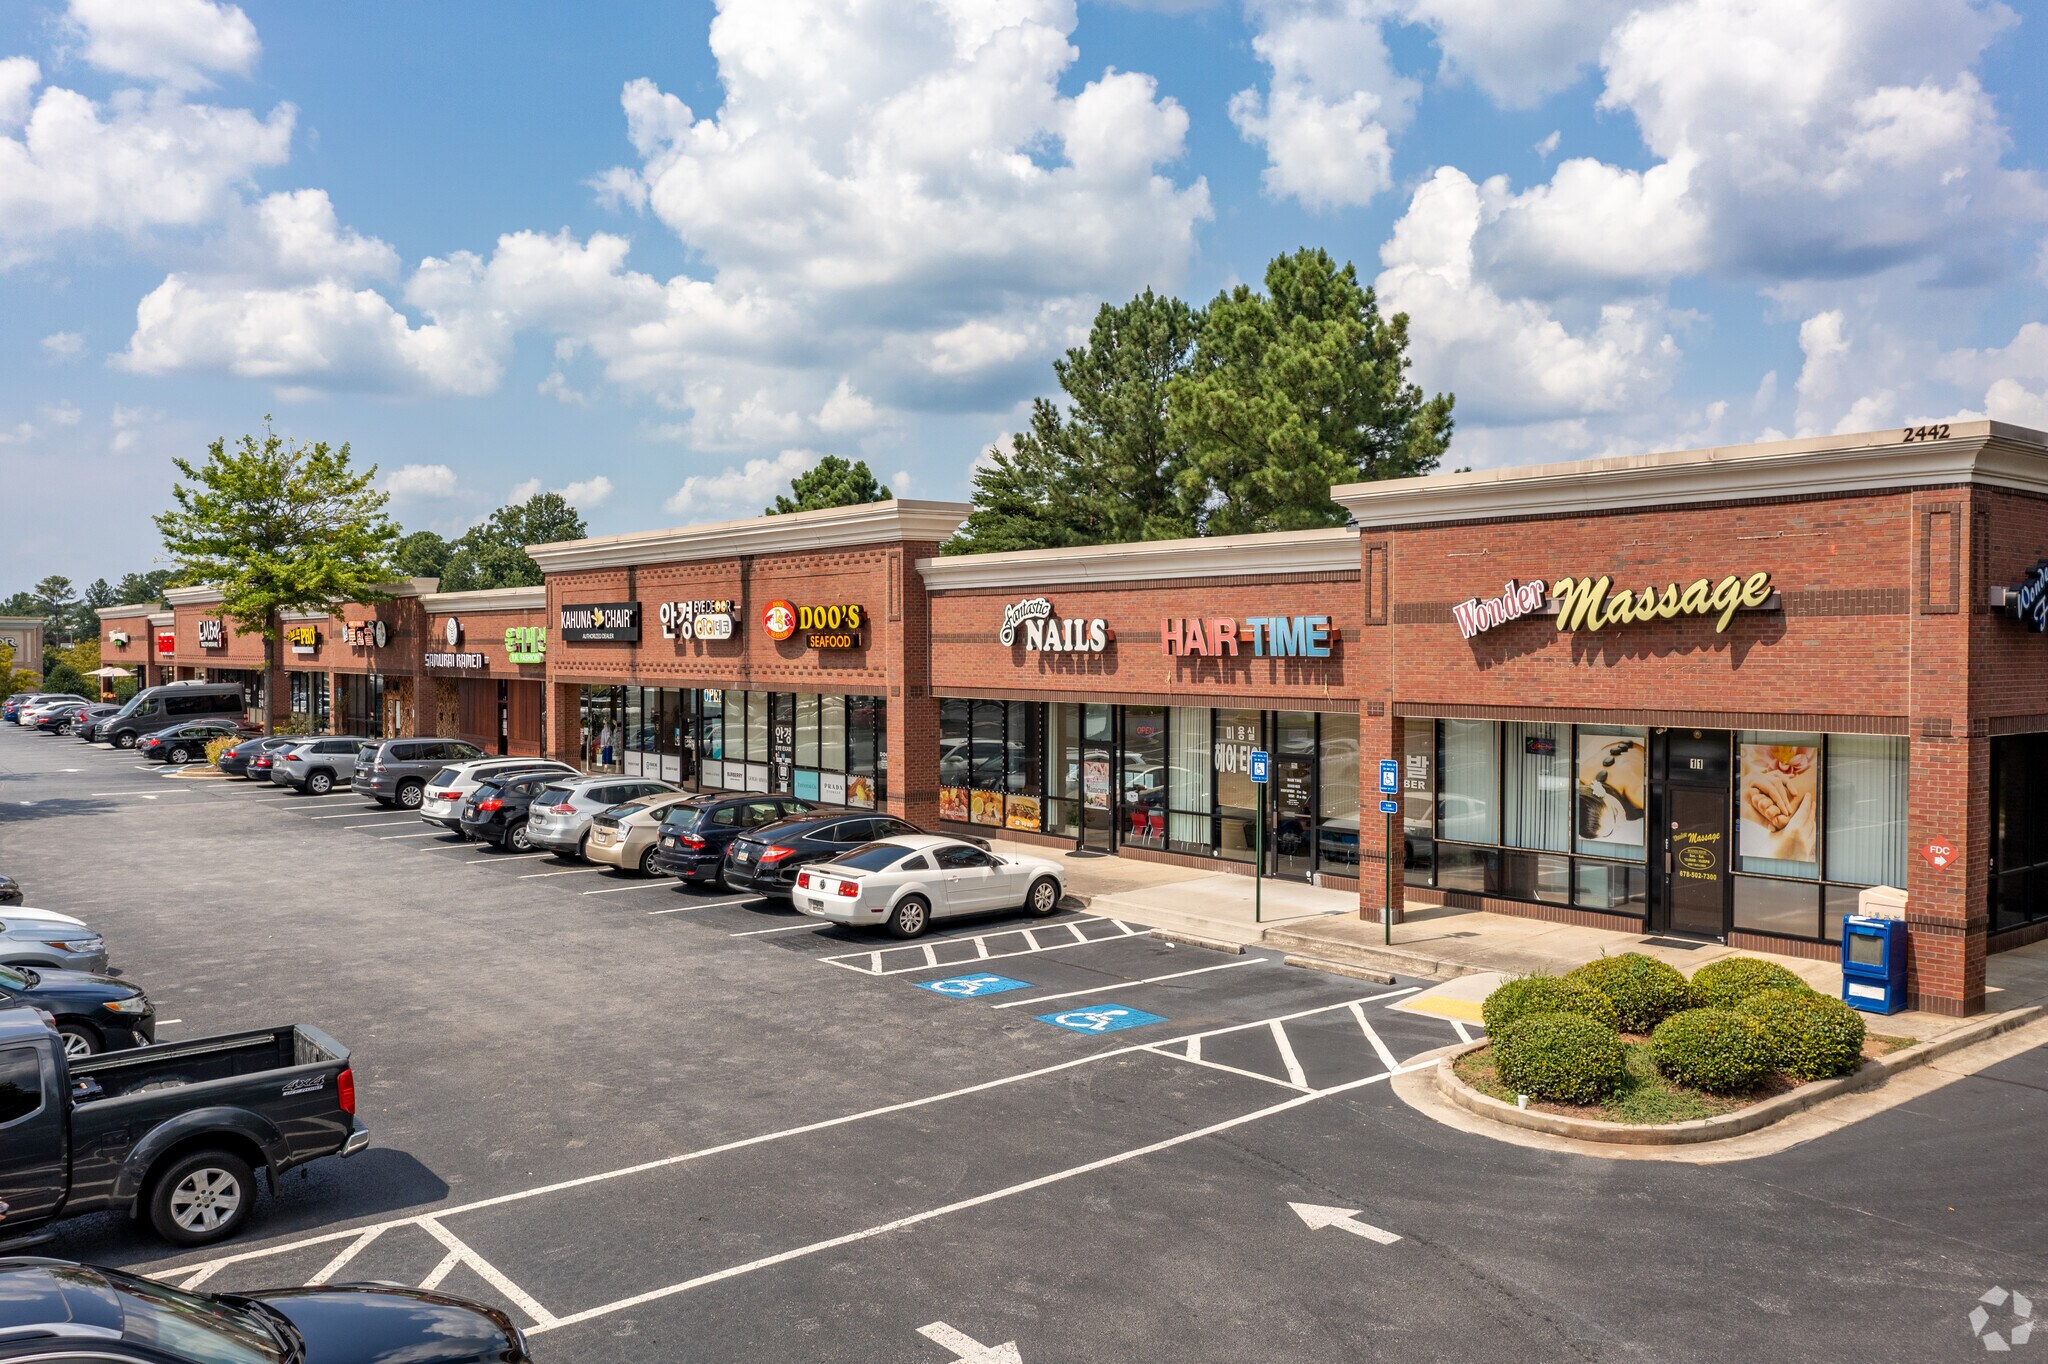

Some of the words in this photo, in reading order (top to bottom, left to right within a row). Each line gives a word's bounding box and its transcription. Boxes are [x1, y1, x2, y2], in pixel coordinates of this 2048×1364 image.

[1903, 424, 1950, 443] 2442
[1453, 579, 1546, 640] Wonder
[1552, 572, 1771, 634] Massage
[561, 611, 592, 629] KAHUNA
[659, 601, 693, 639] 안경
[799, 605, 860, 630] DOO'S
[810, 635, 851, 648] SEAFOOD
[1025, 618, 1106, 652] NAILS
[1160, 616, 1239, 656] HAIR
[1245, 615, 1331, 657] TIME
[425, 653, 455, 668] SAMURAI
[456, 653, 482, 669] RAMEN
[775, 726, 792, 744] 안경
[1136, 726, 1155, 735] OPEN
[1690, 758, 1703, 770] 11
[824, 783, 843, 791] PRADA
[1688, 832, 1720, 844] Massage
[1929, 845, 1950, 855] FDC
